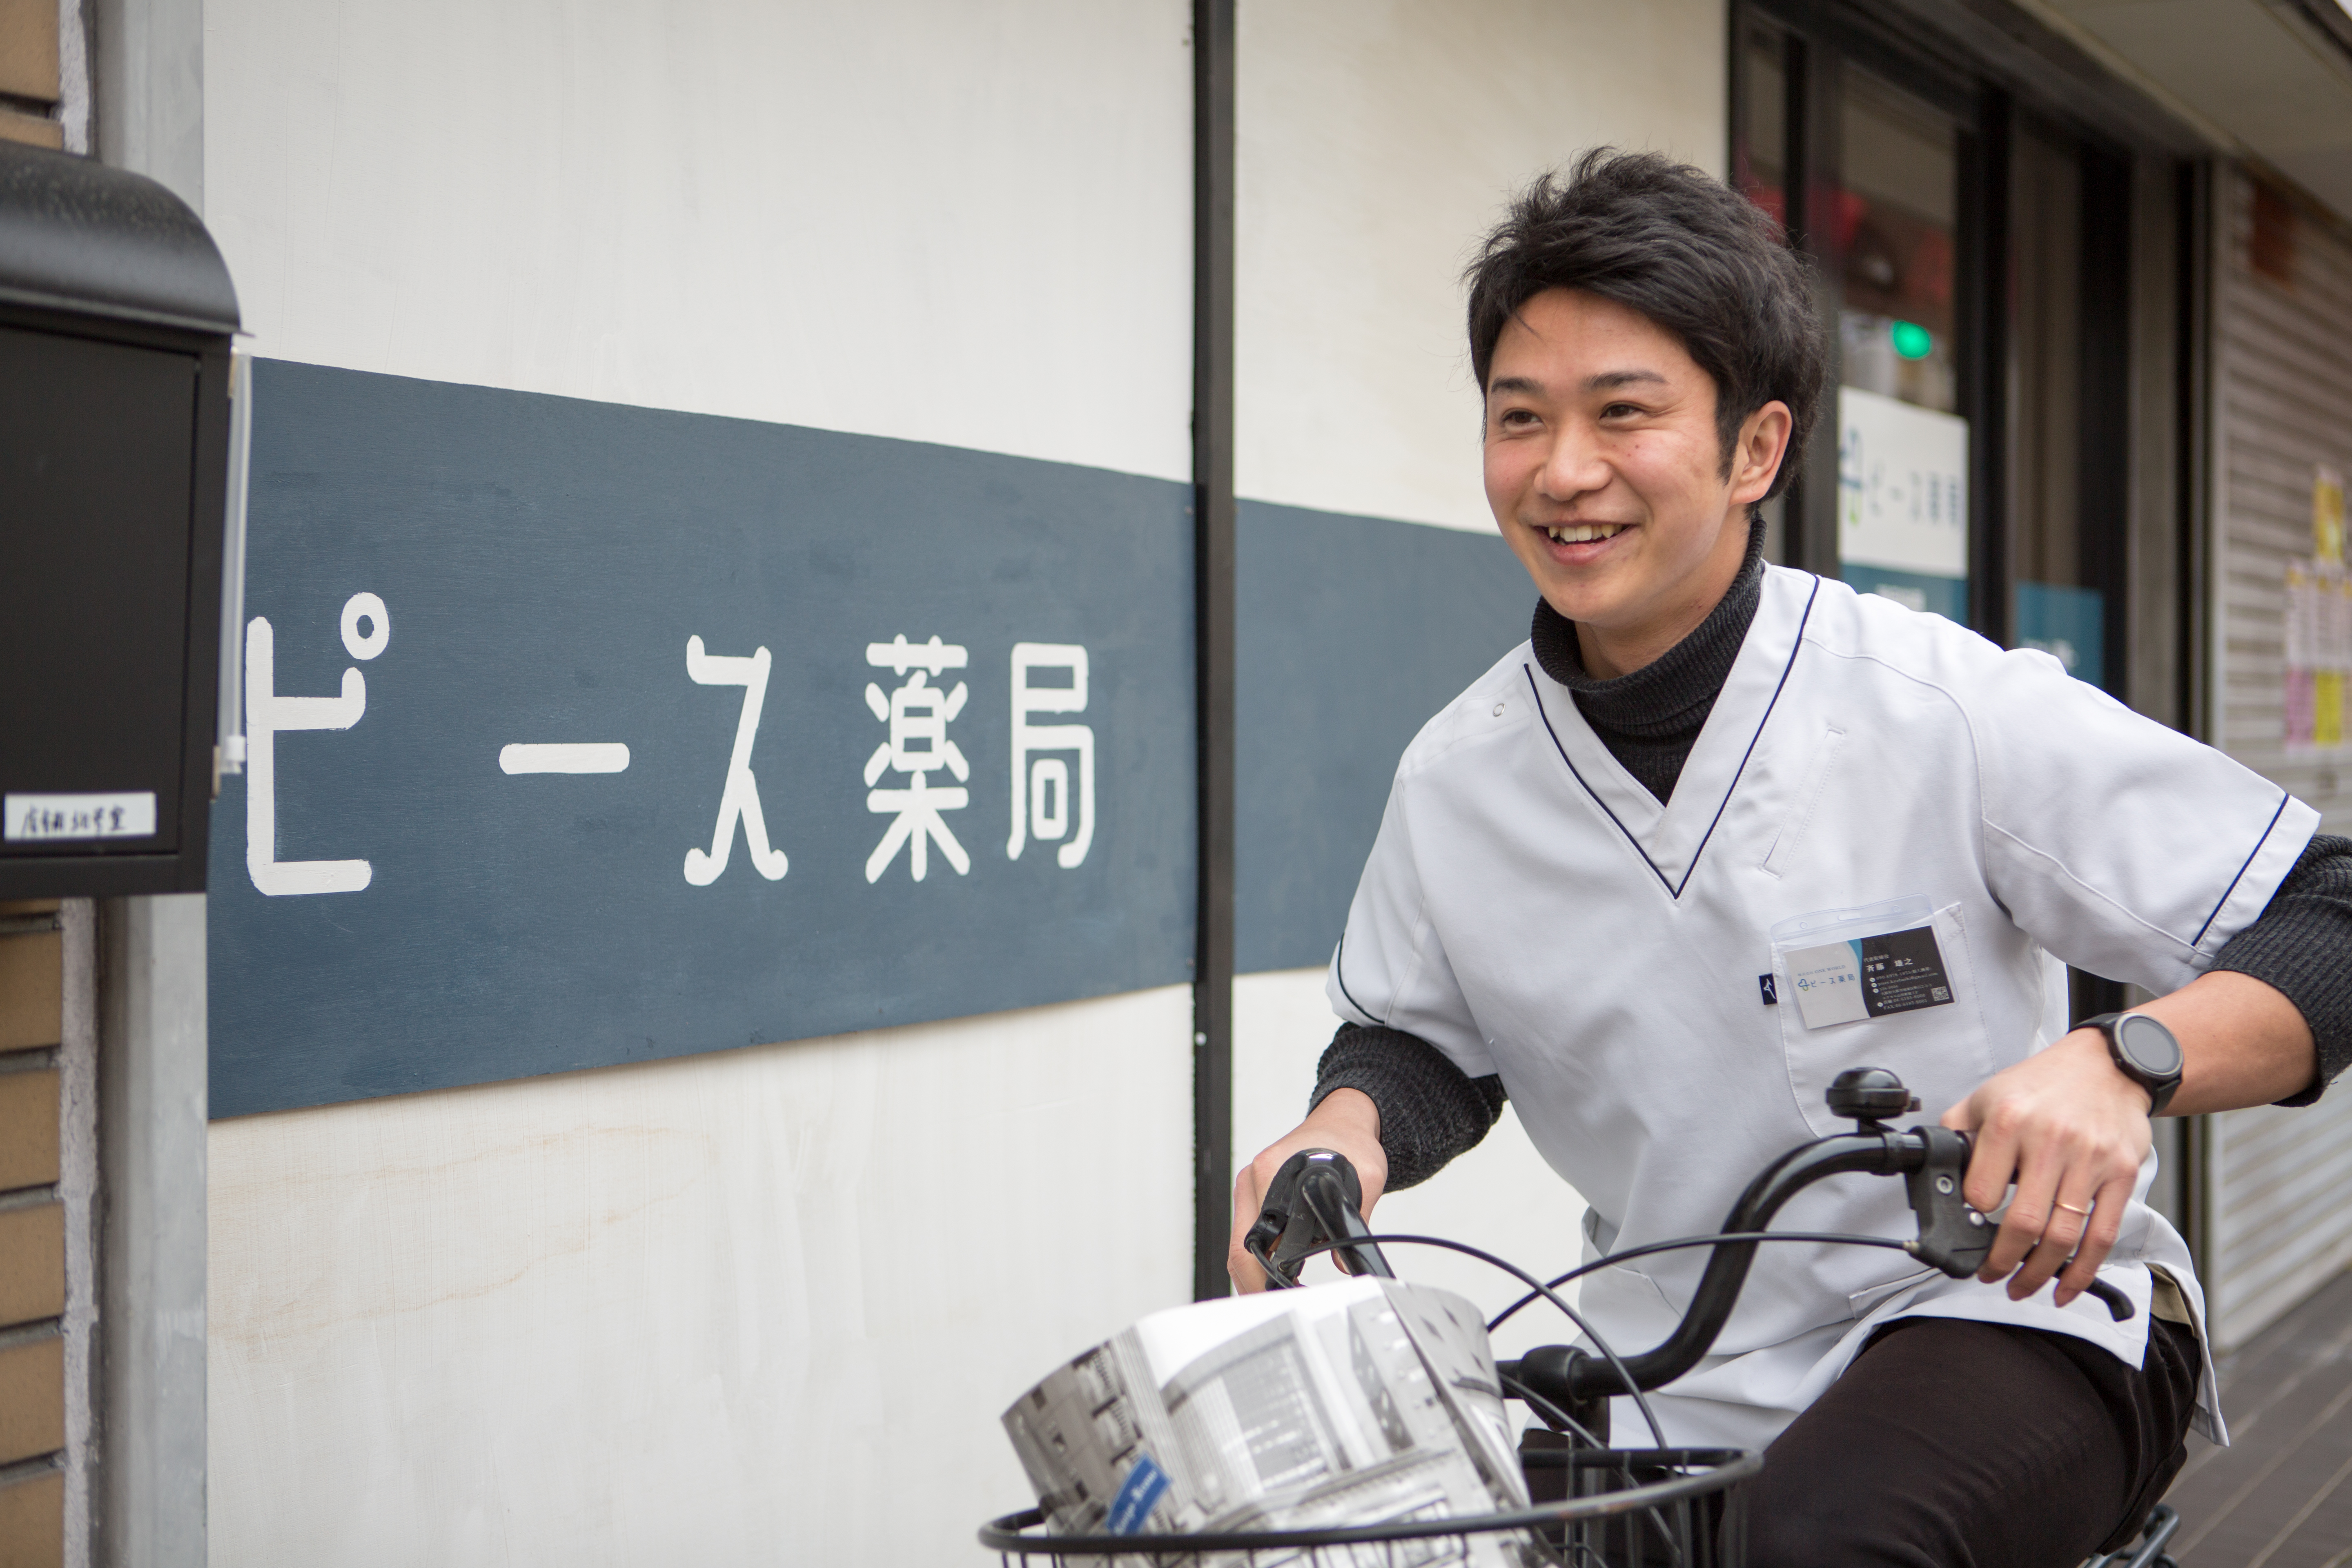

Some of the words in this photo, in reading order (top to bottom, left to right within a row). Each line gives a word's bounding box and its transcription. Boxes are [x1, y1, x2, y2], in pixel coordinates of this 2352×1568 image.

[246, 592, 1095, 896] ピース薬局
[1811, 973, 1855, 987] ピース薬局
